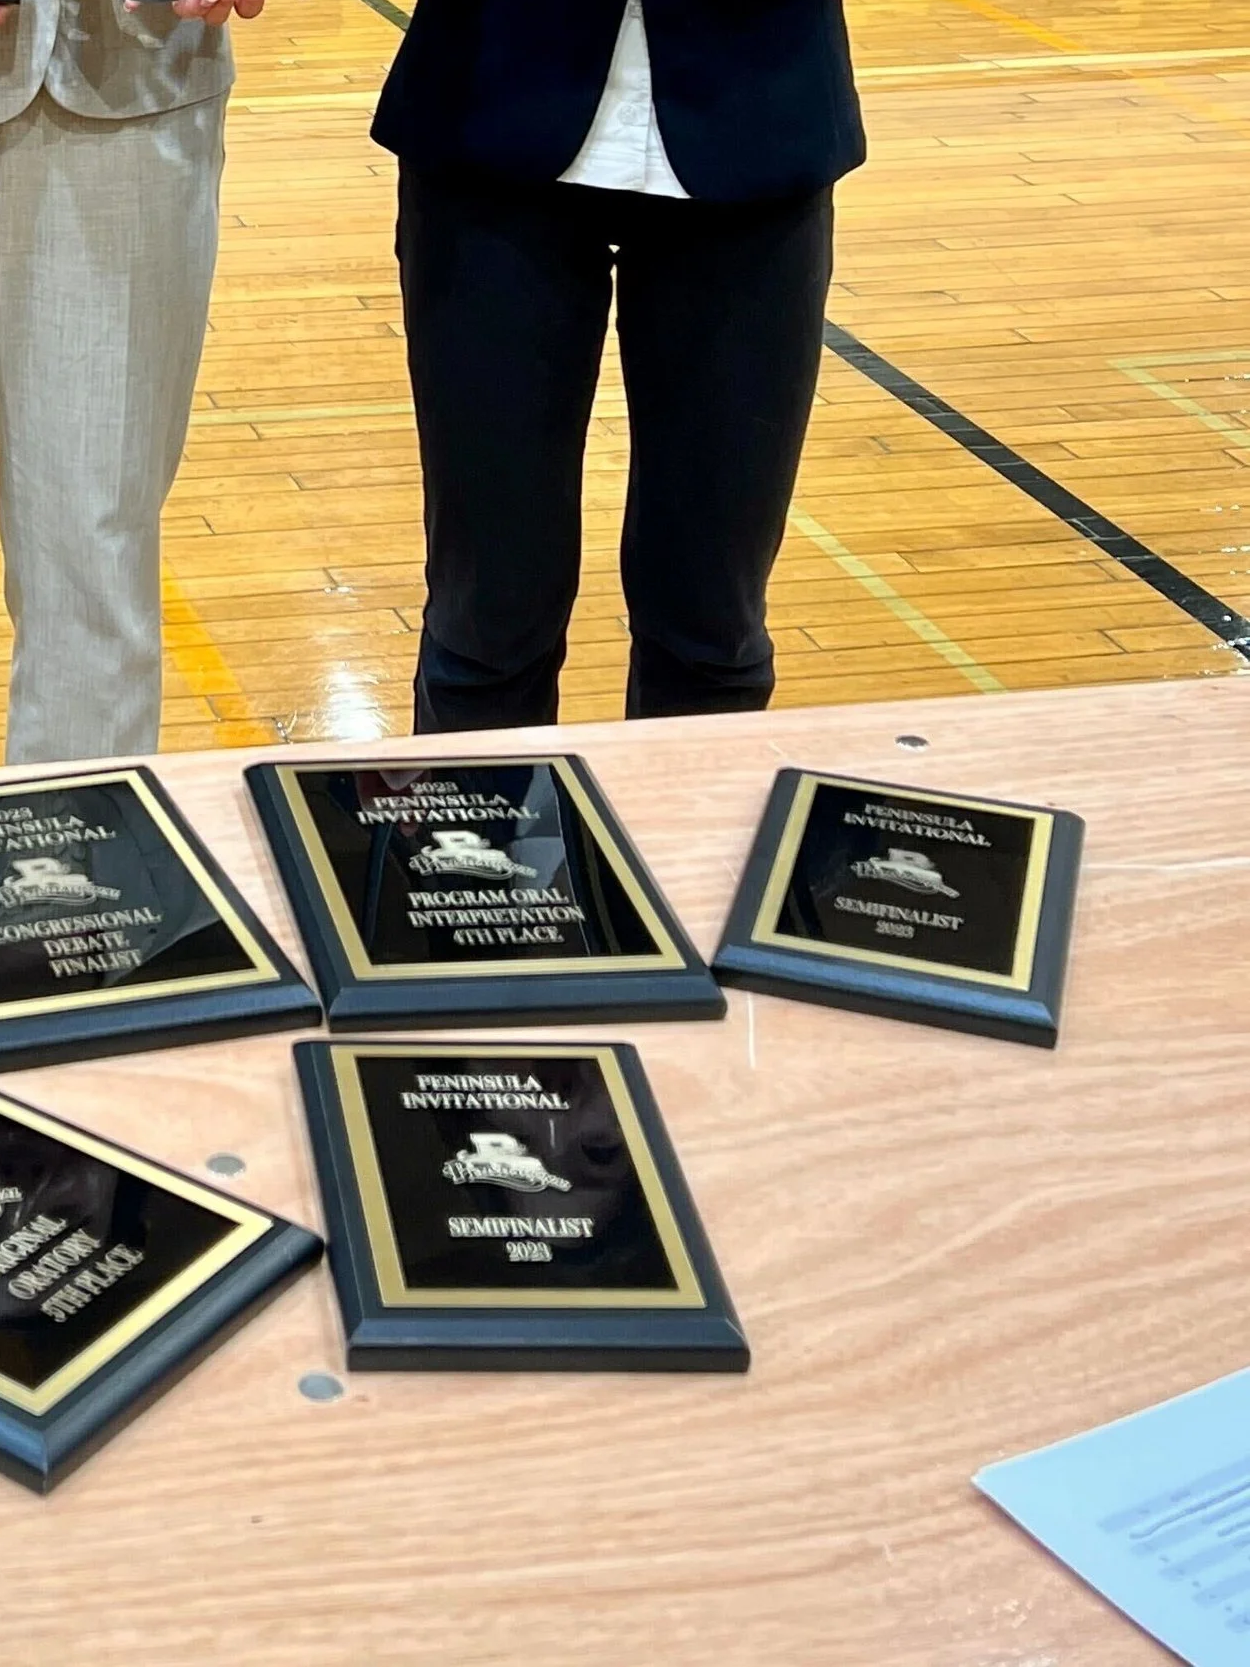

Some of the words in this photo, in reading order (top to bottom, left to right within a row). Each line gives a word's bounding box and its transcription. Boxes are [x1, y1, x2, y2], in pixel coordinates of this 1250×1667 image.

[410, 782, 458, 794] 2023
[373, 794, 510, 810] PENINSULA
[356, 806, 540, 824] INVITATIONAL
[864, 804, 973, 831] PENINSULA
[844, 813, 992, 847] INVITATIONAL
[407, 889, 509, 909] PROGRAM
[511, 888, 569, 904] ORAL
[407, 906, 585, 928] INTERPRETATION
[834, 896, 965, 931] SEMIFINALIST
[43, 931, 130, 956] DEBATE
[453, 929, 493, 946] 4TH
[497, 926, 565, 945] PLACE
[50, 949, 142, 977] FINALIST
[416, 1075, 543, 1091] PENINSULA
[401, 1092, 570, 1110] INVITATIONAL
[449, 1217, 595, 1237] SEMIFINALIST
[506, 1241, 552, 1262] 2023
[8, 1228, 103, 1300] ORATORY
[40, 1287, 91, 1323] 5TH
[80, 1244, 145, 1296] PLACE
